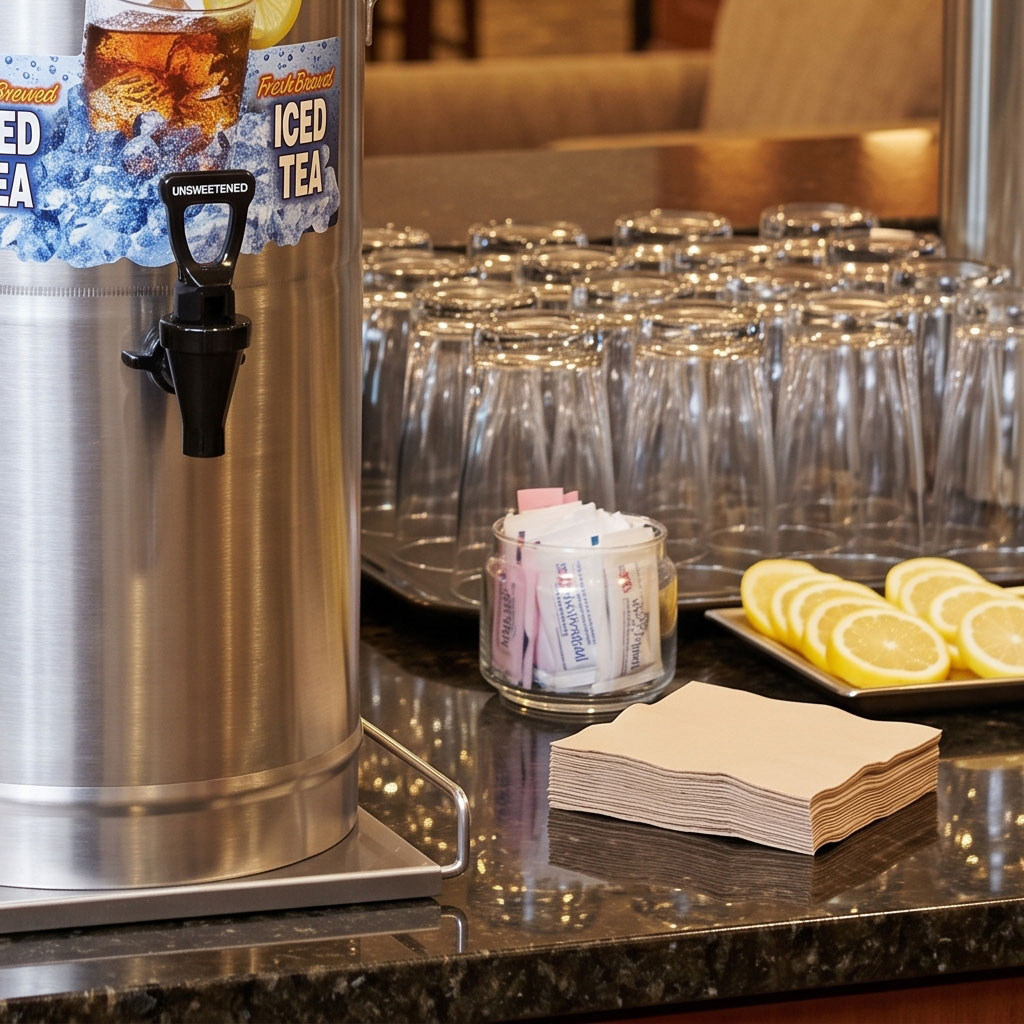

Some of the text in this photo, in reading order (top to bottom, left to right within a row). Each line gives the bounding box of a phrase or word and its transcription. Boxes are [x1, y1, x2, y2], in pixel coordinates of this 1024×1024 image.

[274, 97, 327, 148] ICED
[172, 182, 249, 197] UNSWEETENED
[279, 150, 324, 199] TEA
